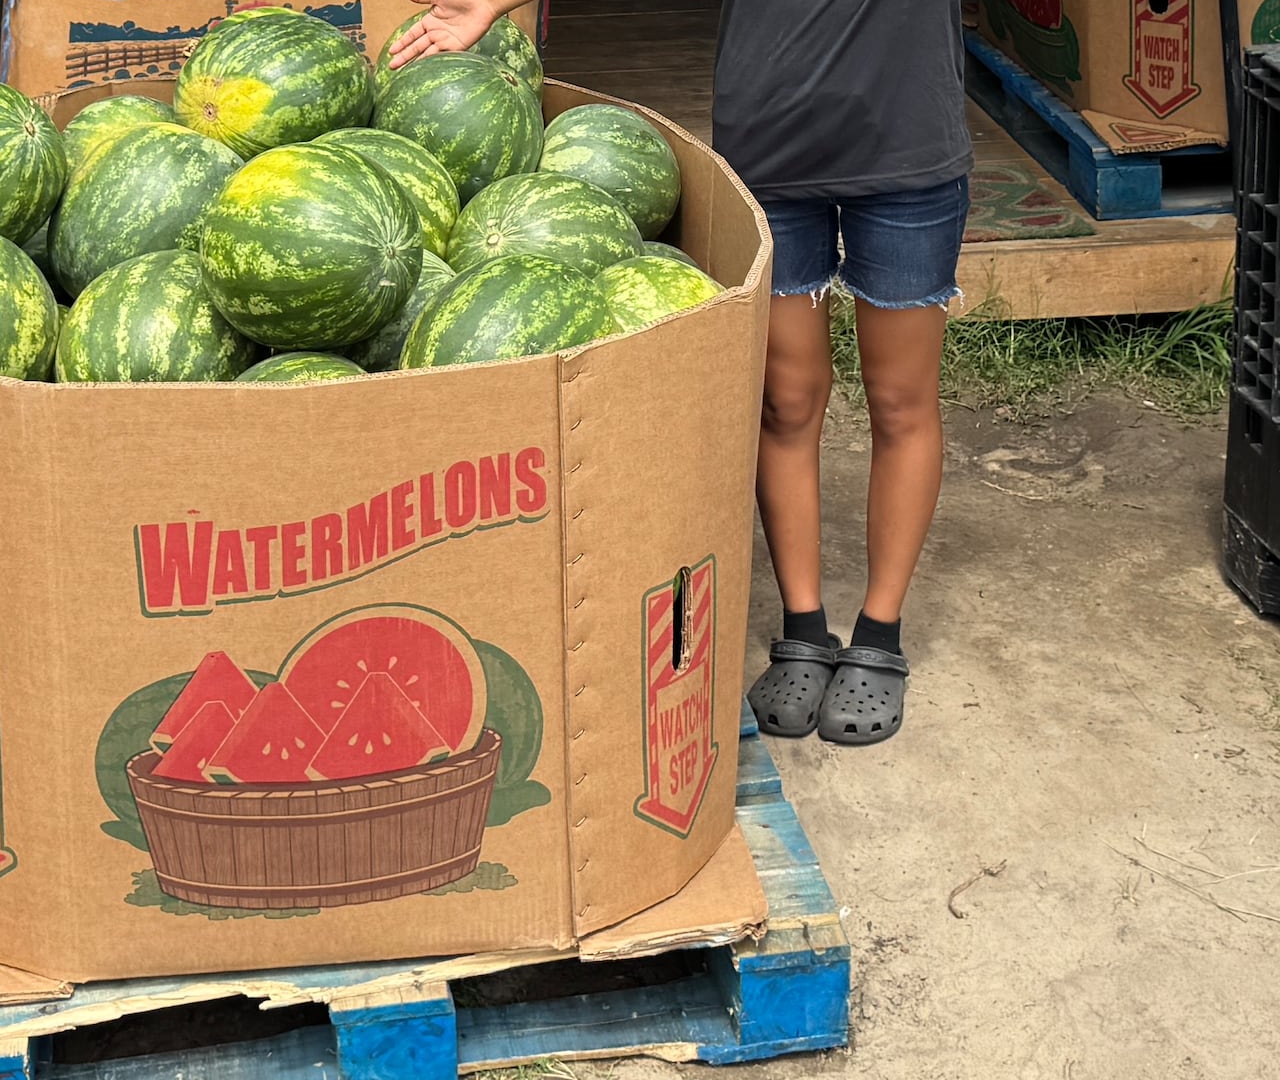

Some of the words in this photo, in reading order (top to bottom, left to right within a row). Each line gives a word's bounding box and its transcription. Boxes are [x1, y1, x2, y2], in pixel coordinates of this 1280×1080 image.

[1144, 35, 1180, 62] WATCH
[1149, 64, 1174, 90] STEP
[139, 447, 548, 608] WATERMELONS
[660, 687, 703, 751] WATCH
[670, 740, 698, 795] STEP
